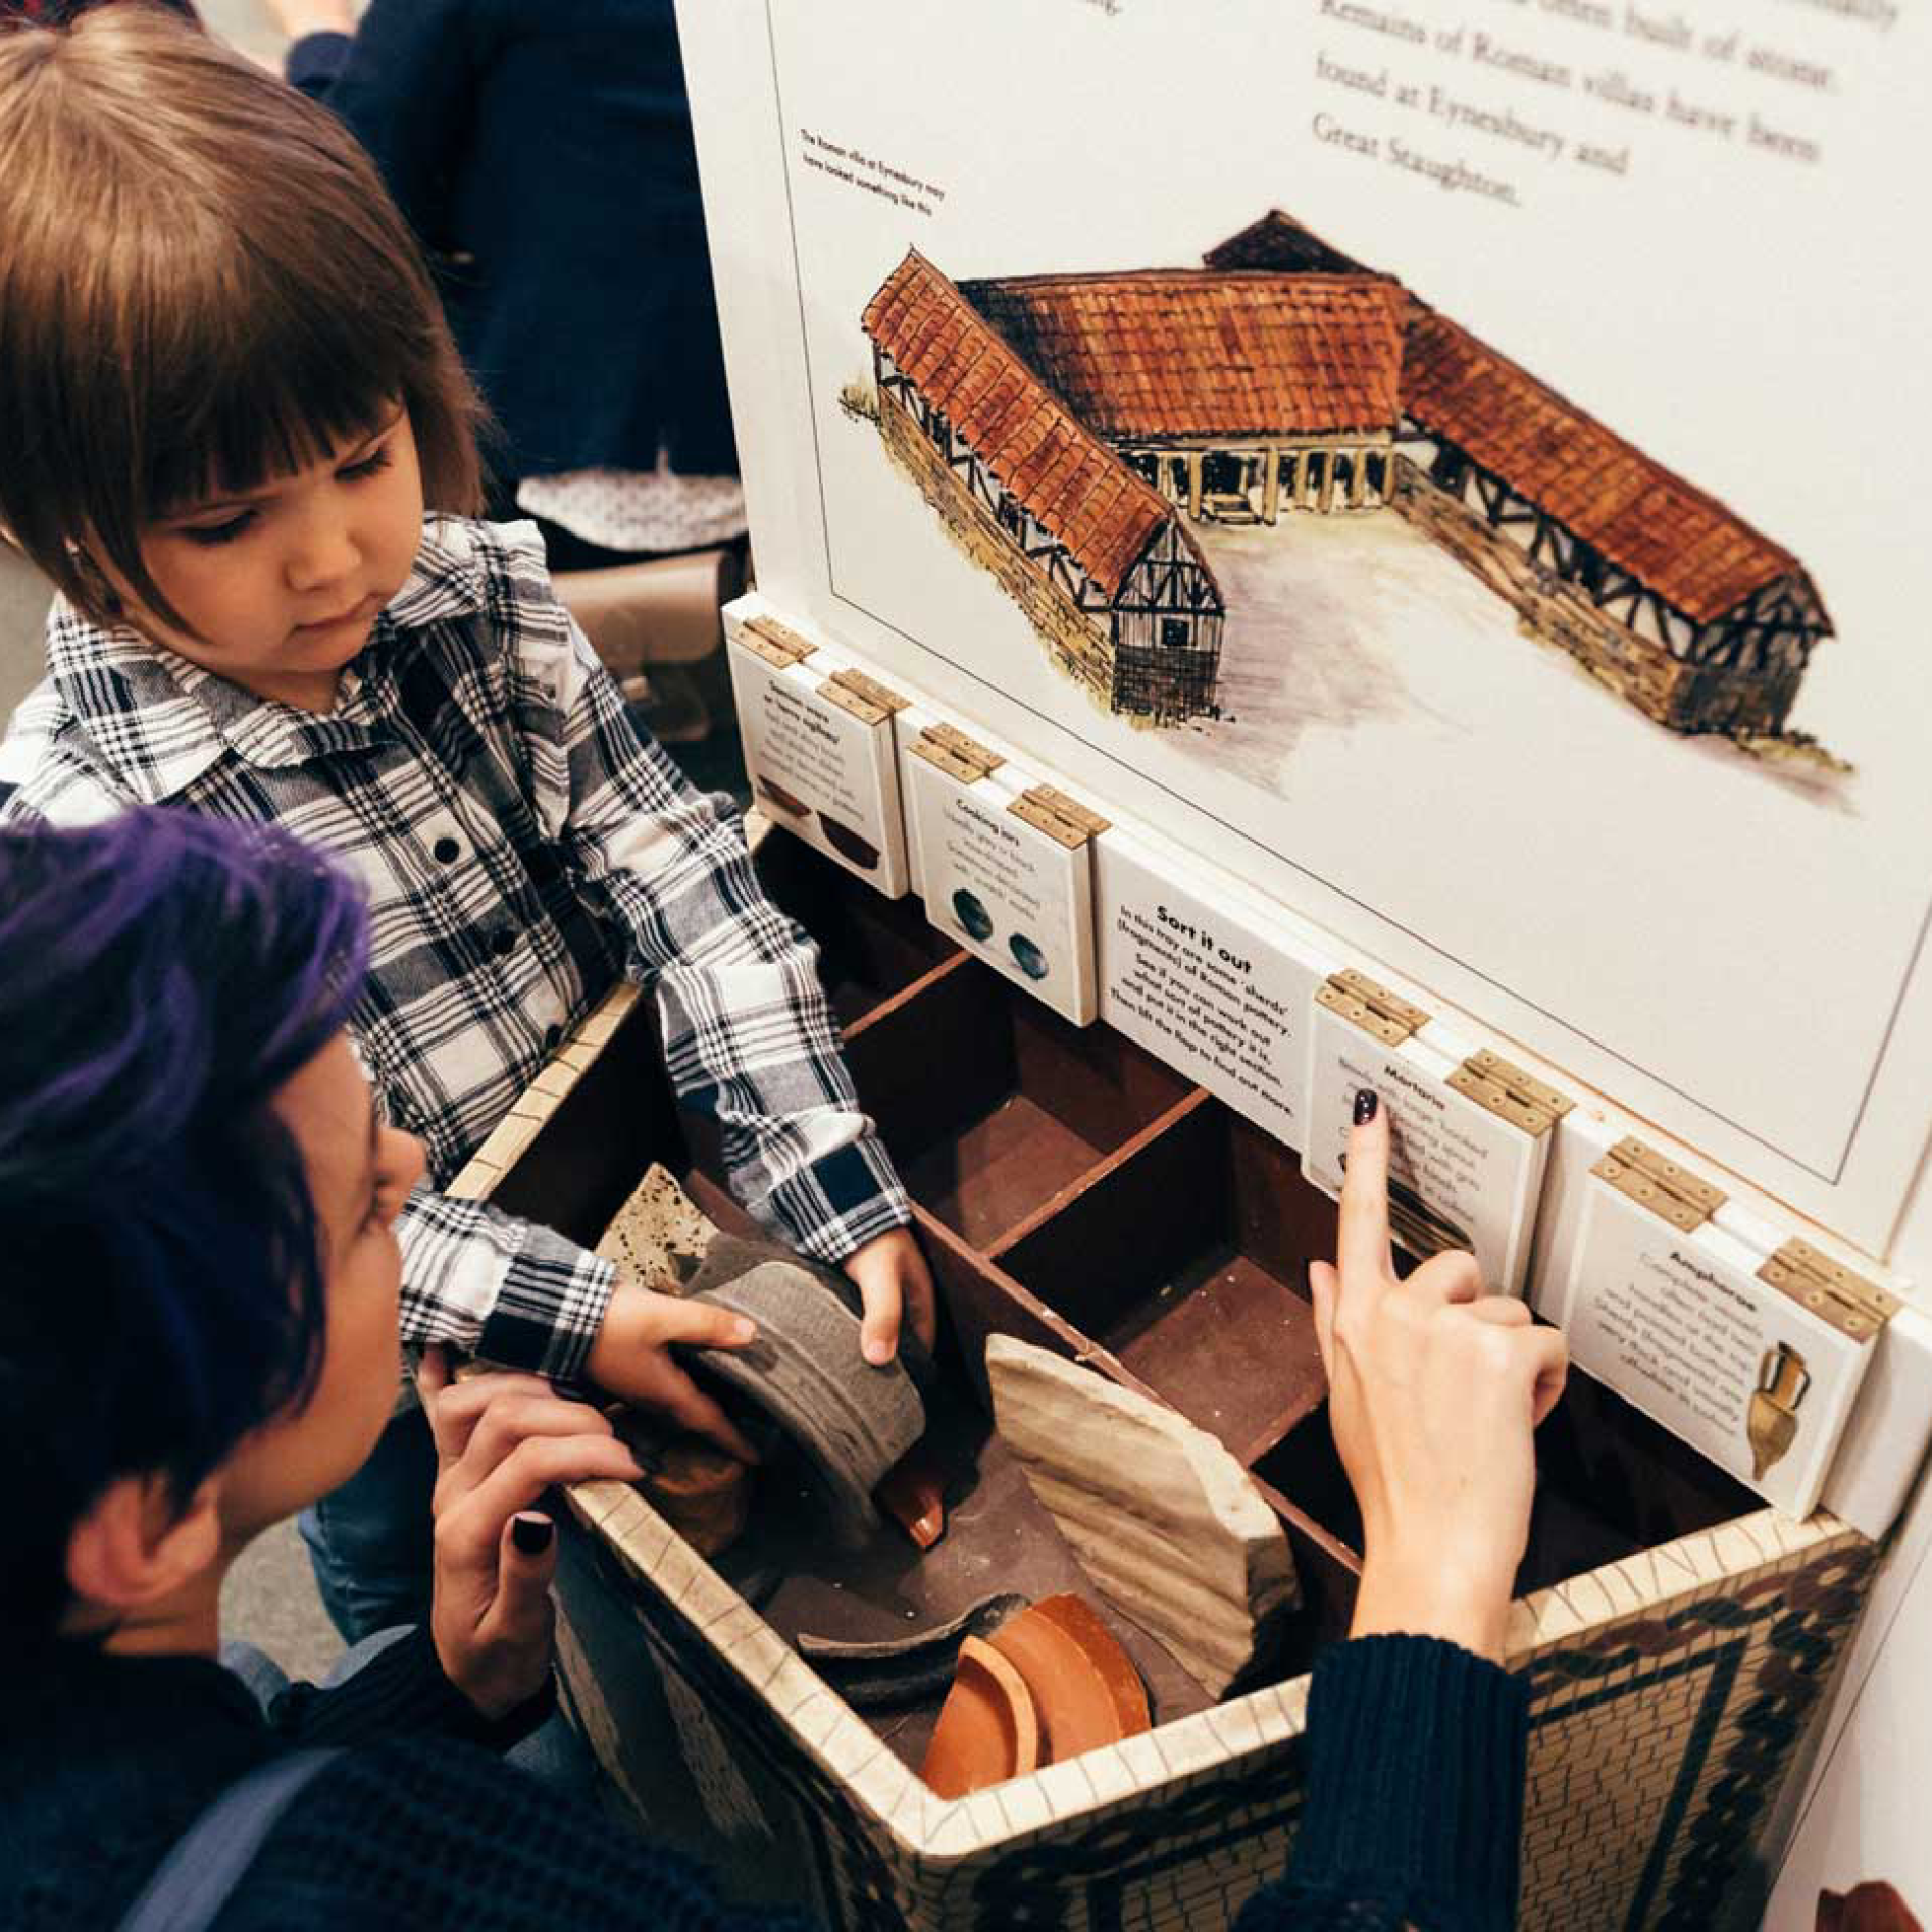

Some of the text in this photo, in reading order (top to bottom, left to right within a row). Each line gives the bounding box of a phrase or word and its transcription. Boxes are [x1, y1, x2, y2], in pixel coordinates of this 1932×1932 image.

[1315, 49, 1629, 176] found at Eynesbury and
[1434, 23, 1465, 53] of
[1473, 33, 1571, 87] Roman
[1584, 71, 1653, 112] villas
[1667, 87, 1736, 134] have
[1746, 111, 1822, 162] been
[1312, 111, 1522, 208] Great Staughton.
[1120, 905, 1132, 919] In
[1135, 914, 1154, 933] this
[1156, 928, 1180, 950] tray
[1182, 947, 1203, 964] are
[1207, 961, 1237, 985] some
[1157, 905, 1251, 974] Sort it out
[1120, 977, 1284, 1088] and put it in the right section.
[1134, 968, 1162, 990] what
[1164, 989, 1186, 1007] sort
[1188, 1005, 1201, 1017] of
[1203, 1014, 1244, 1048] pottery
[1248, 1041, 1257, 1054] it
[1136, 952, 1271, 1047] See if you can work out
[1184, 964, 1198, 978] of
[1199, 971, 1240, 1006] Roman
[1242, 1002, 1292, 1038] pottery.
[1110, 986, 1295, 1117] Then lift the flap to find out more.
[1670, 1251, 1757, 1312] Amphorae
